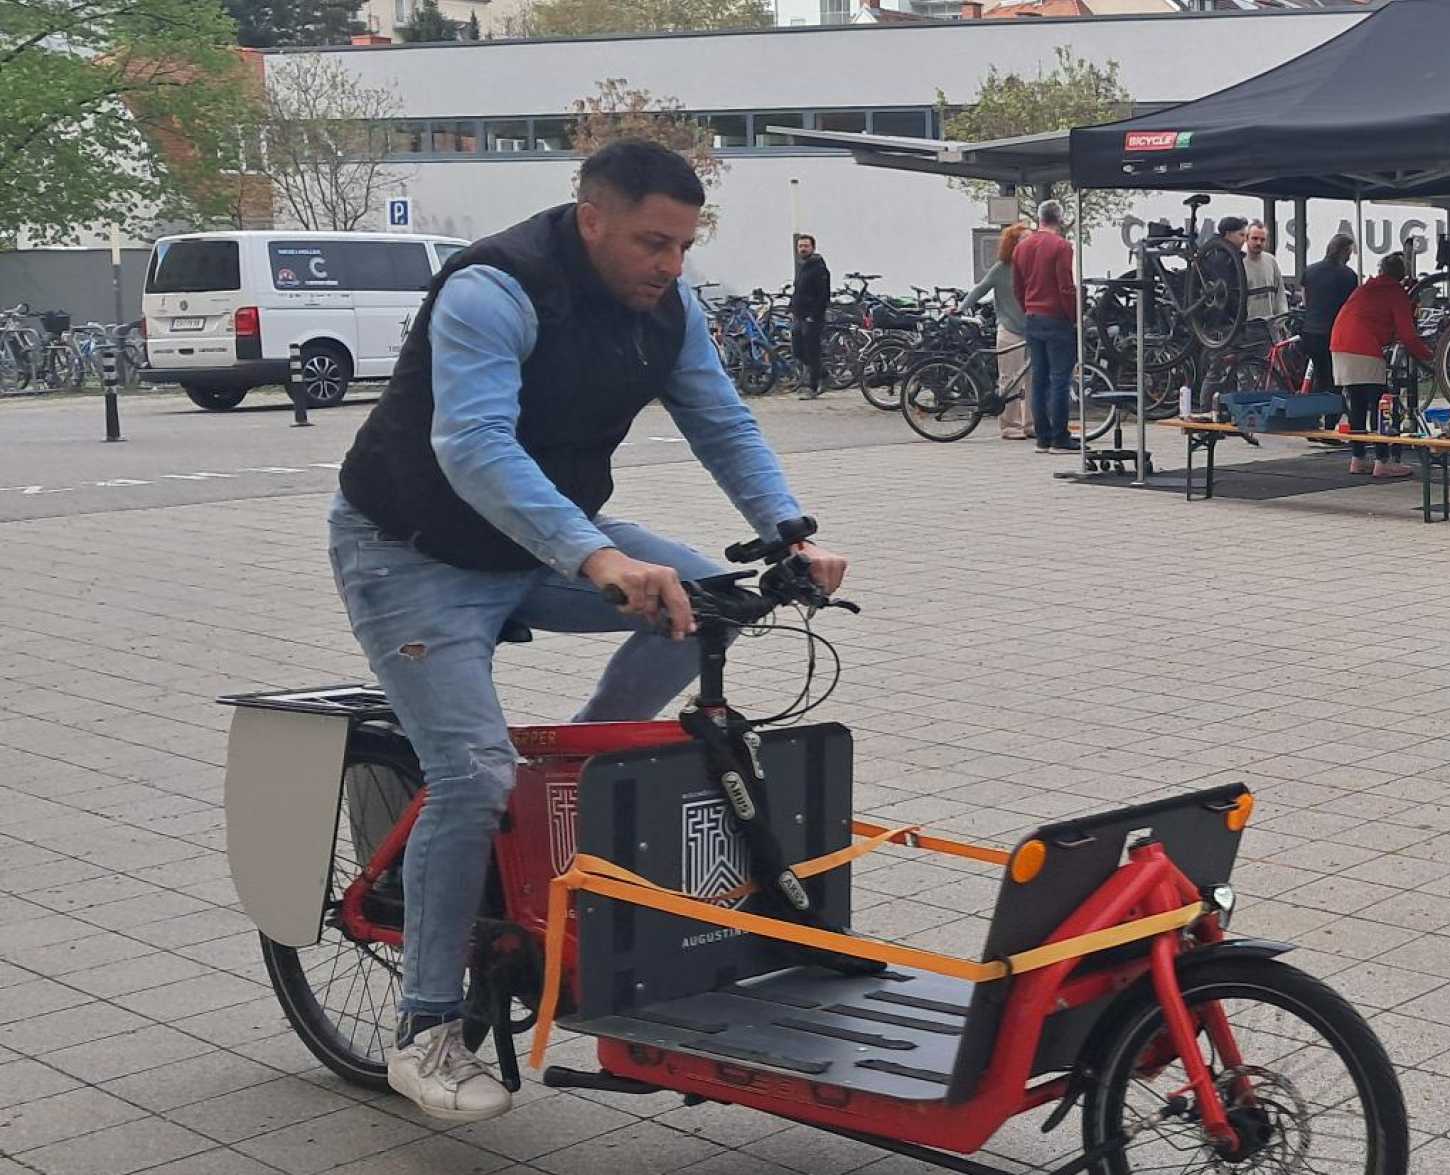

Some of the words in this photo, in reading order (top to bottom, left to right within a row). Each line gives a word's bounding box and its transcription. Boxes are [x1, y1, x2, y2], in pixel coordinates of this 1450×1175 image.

[1128, 135, 1172, 146] BICYCLE
[395, 203, 404, 224] P
[682, 928, 748, 948] AUGUSTIN
